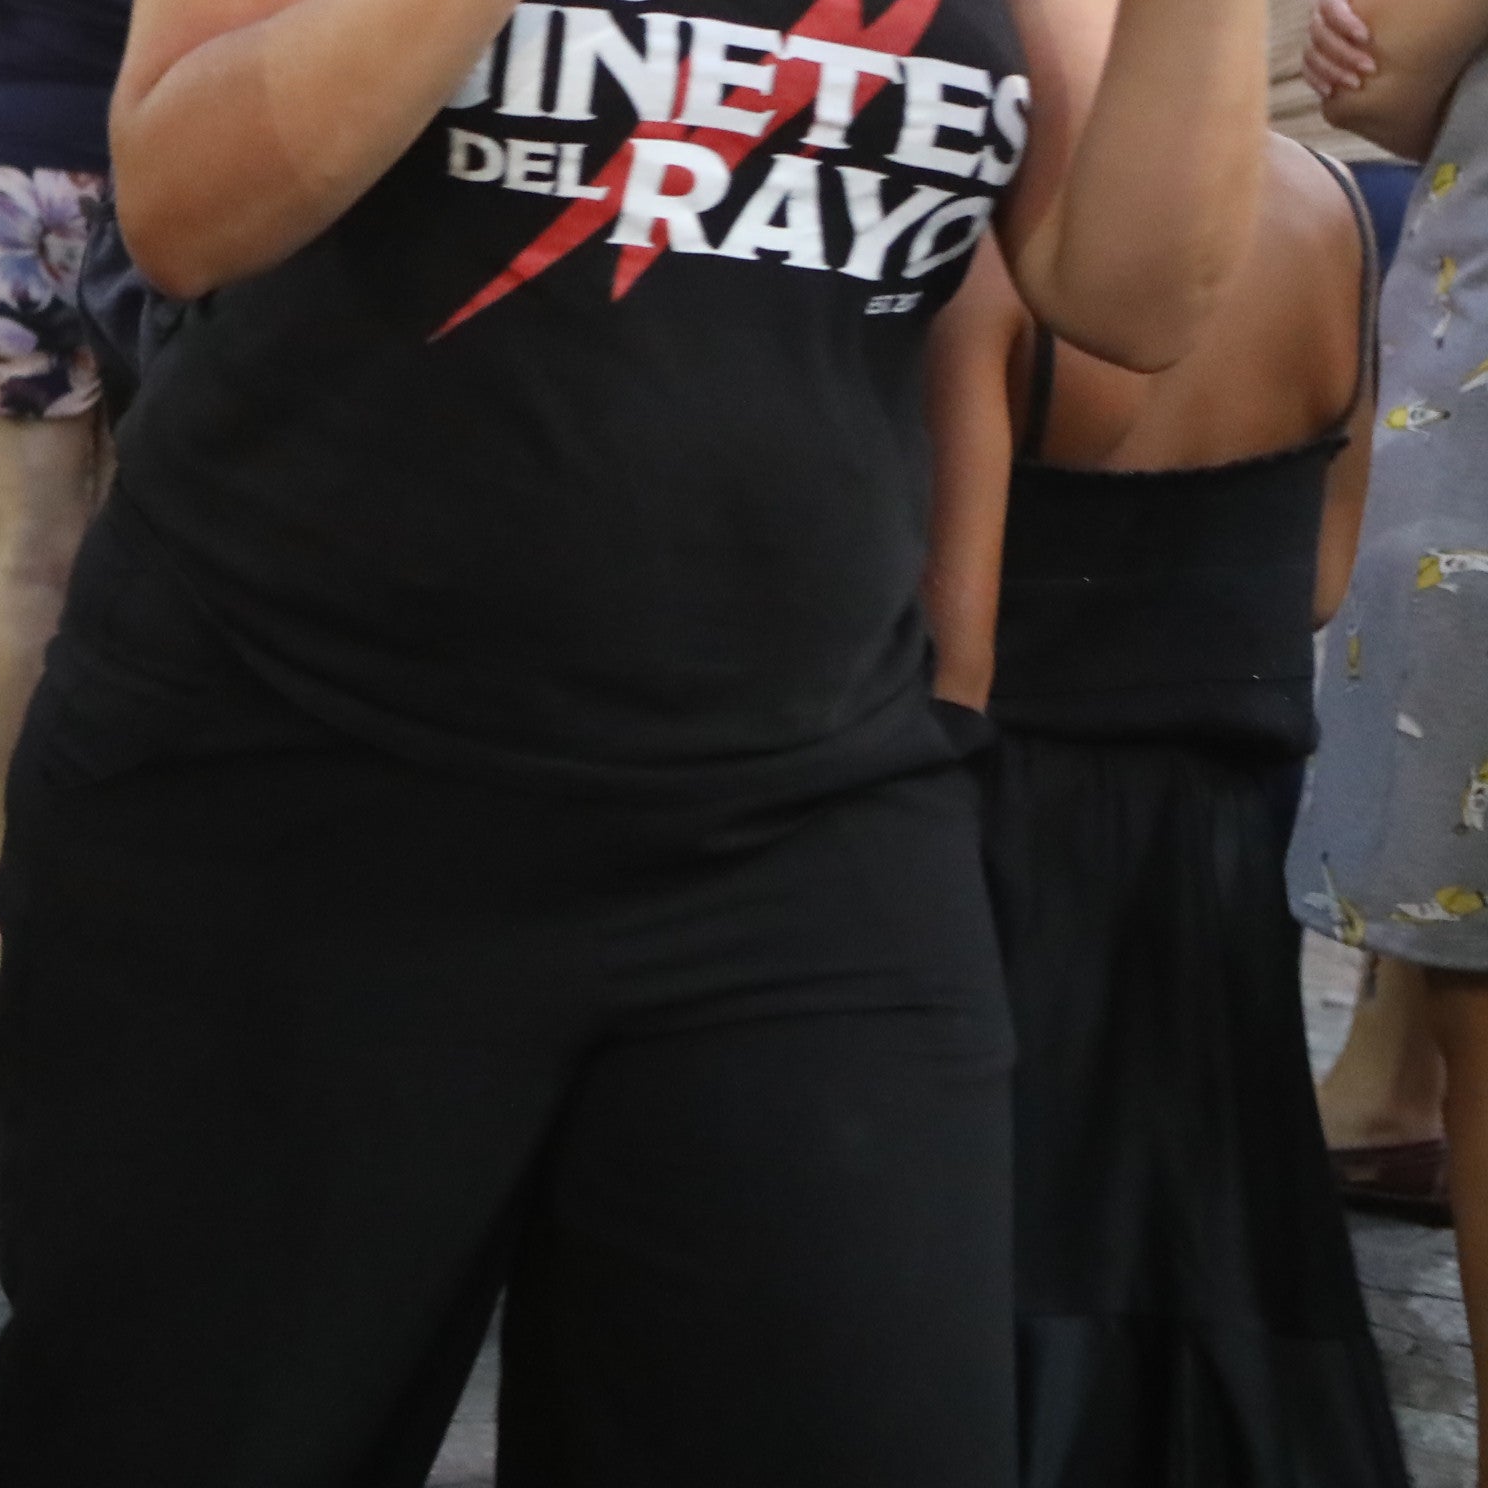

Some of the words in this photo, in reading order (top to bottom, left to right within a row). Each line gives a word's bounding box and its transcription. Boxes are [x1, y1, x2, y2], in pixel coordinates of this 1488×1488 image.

[444, 3, 1030, 187] INETES
[448, 126, 609, 201] DEL
[606, 138, 994, 281] RAYO
